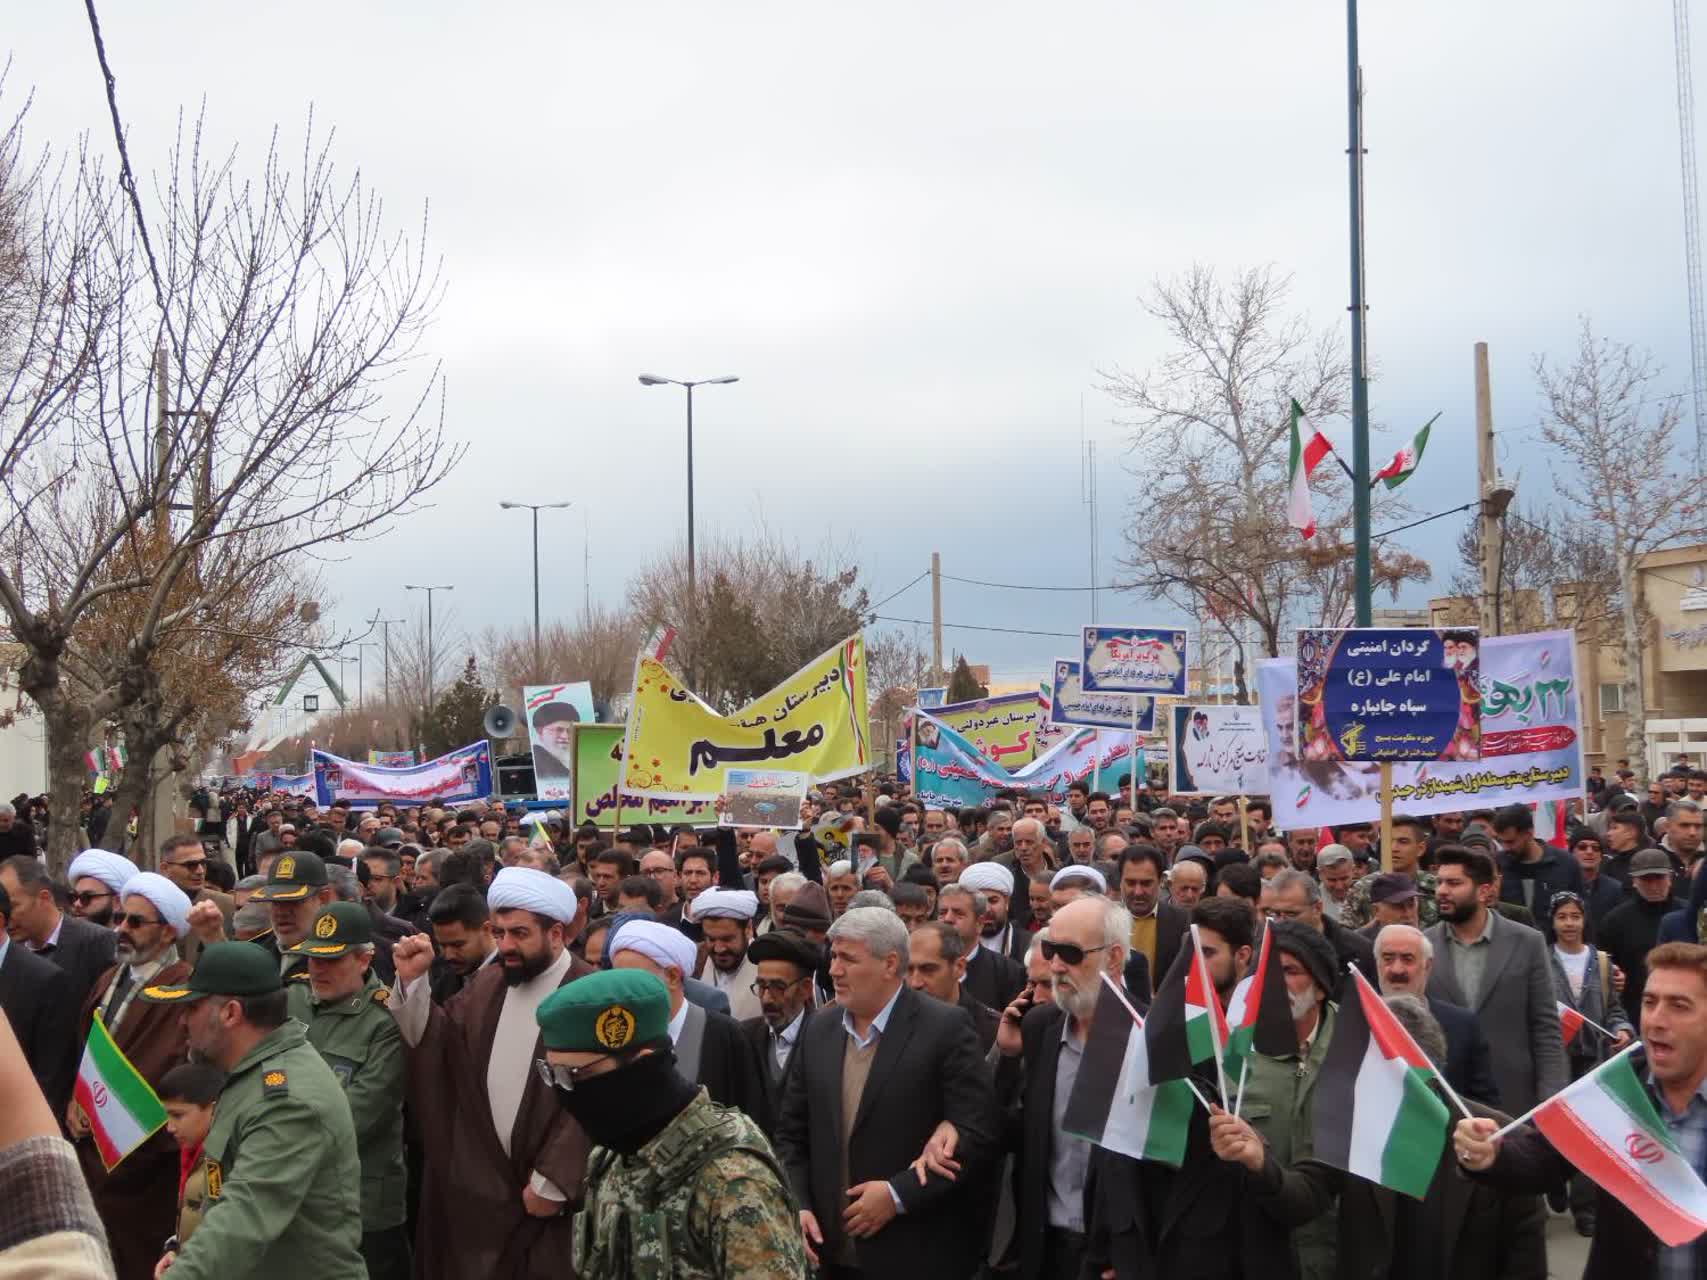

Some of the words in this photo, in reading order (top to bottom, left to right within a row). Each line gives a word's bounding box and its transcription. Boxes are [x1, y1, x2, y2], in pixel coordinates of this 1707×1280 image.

[1347, 639, 1387, 657] امنیتی
[1390, 639, 1430, 656] گردان
[1347, 668, 1372, 687] (ع)
[1375, 669, 1401, 687] علی
[1404, 669, 1431, 687] امام
[773, 666, 841, 723] دبیرستان
[1535, 678, 1571, 719] ۲۲
[1351, 698, 1396, 717] چایپاره
[1399, 698, 1427, 717] سپاه
[689, 723, 824, 775] معلم
[1523, 766, 1569, 787] دبیرستان
